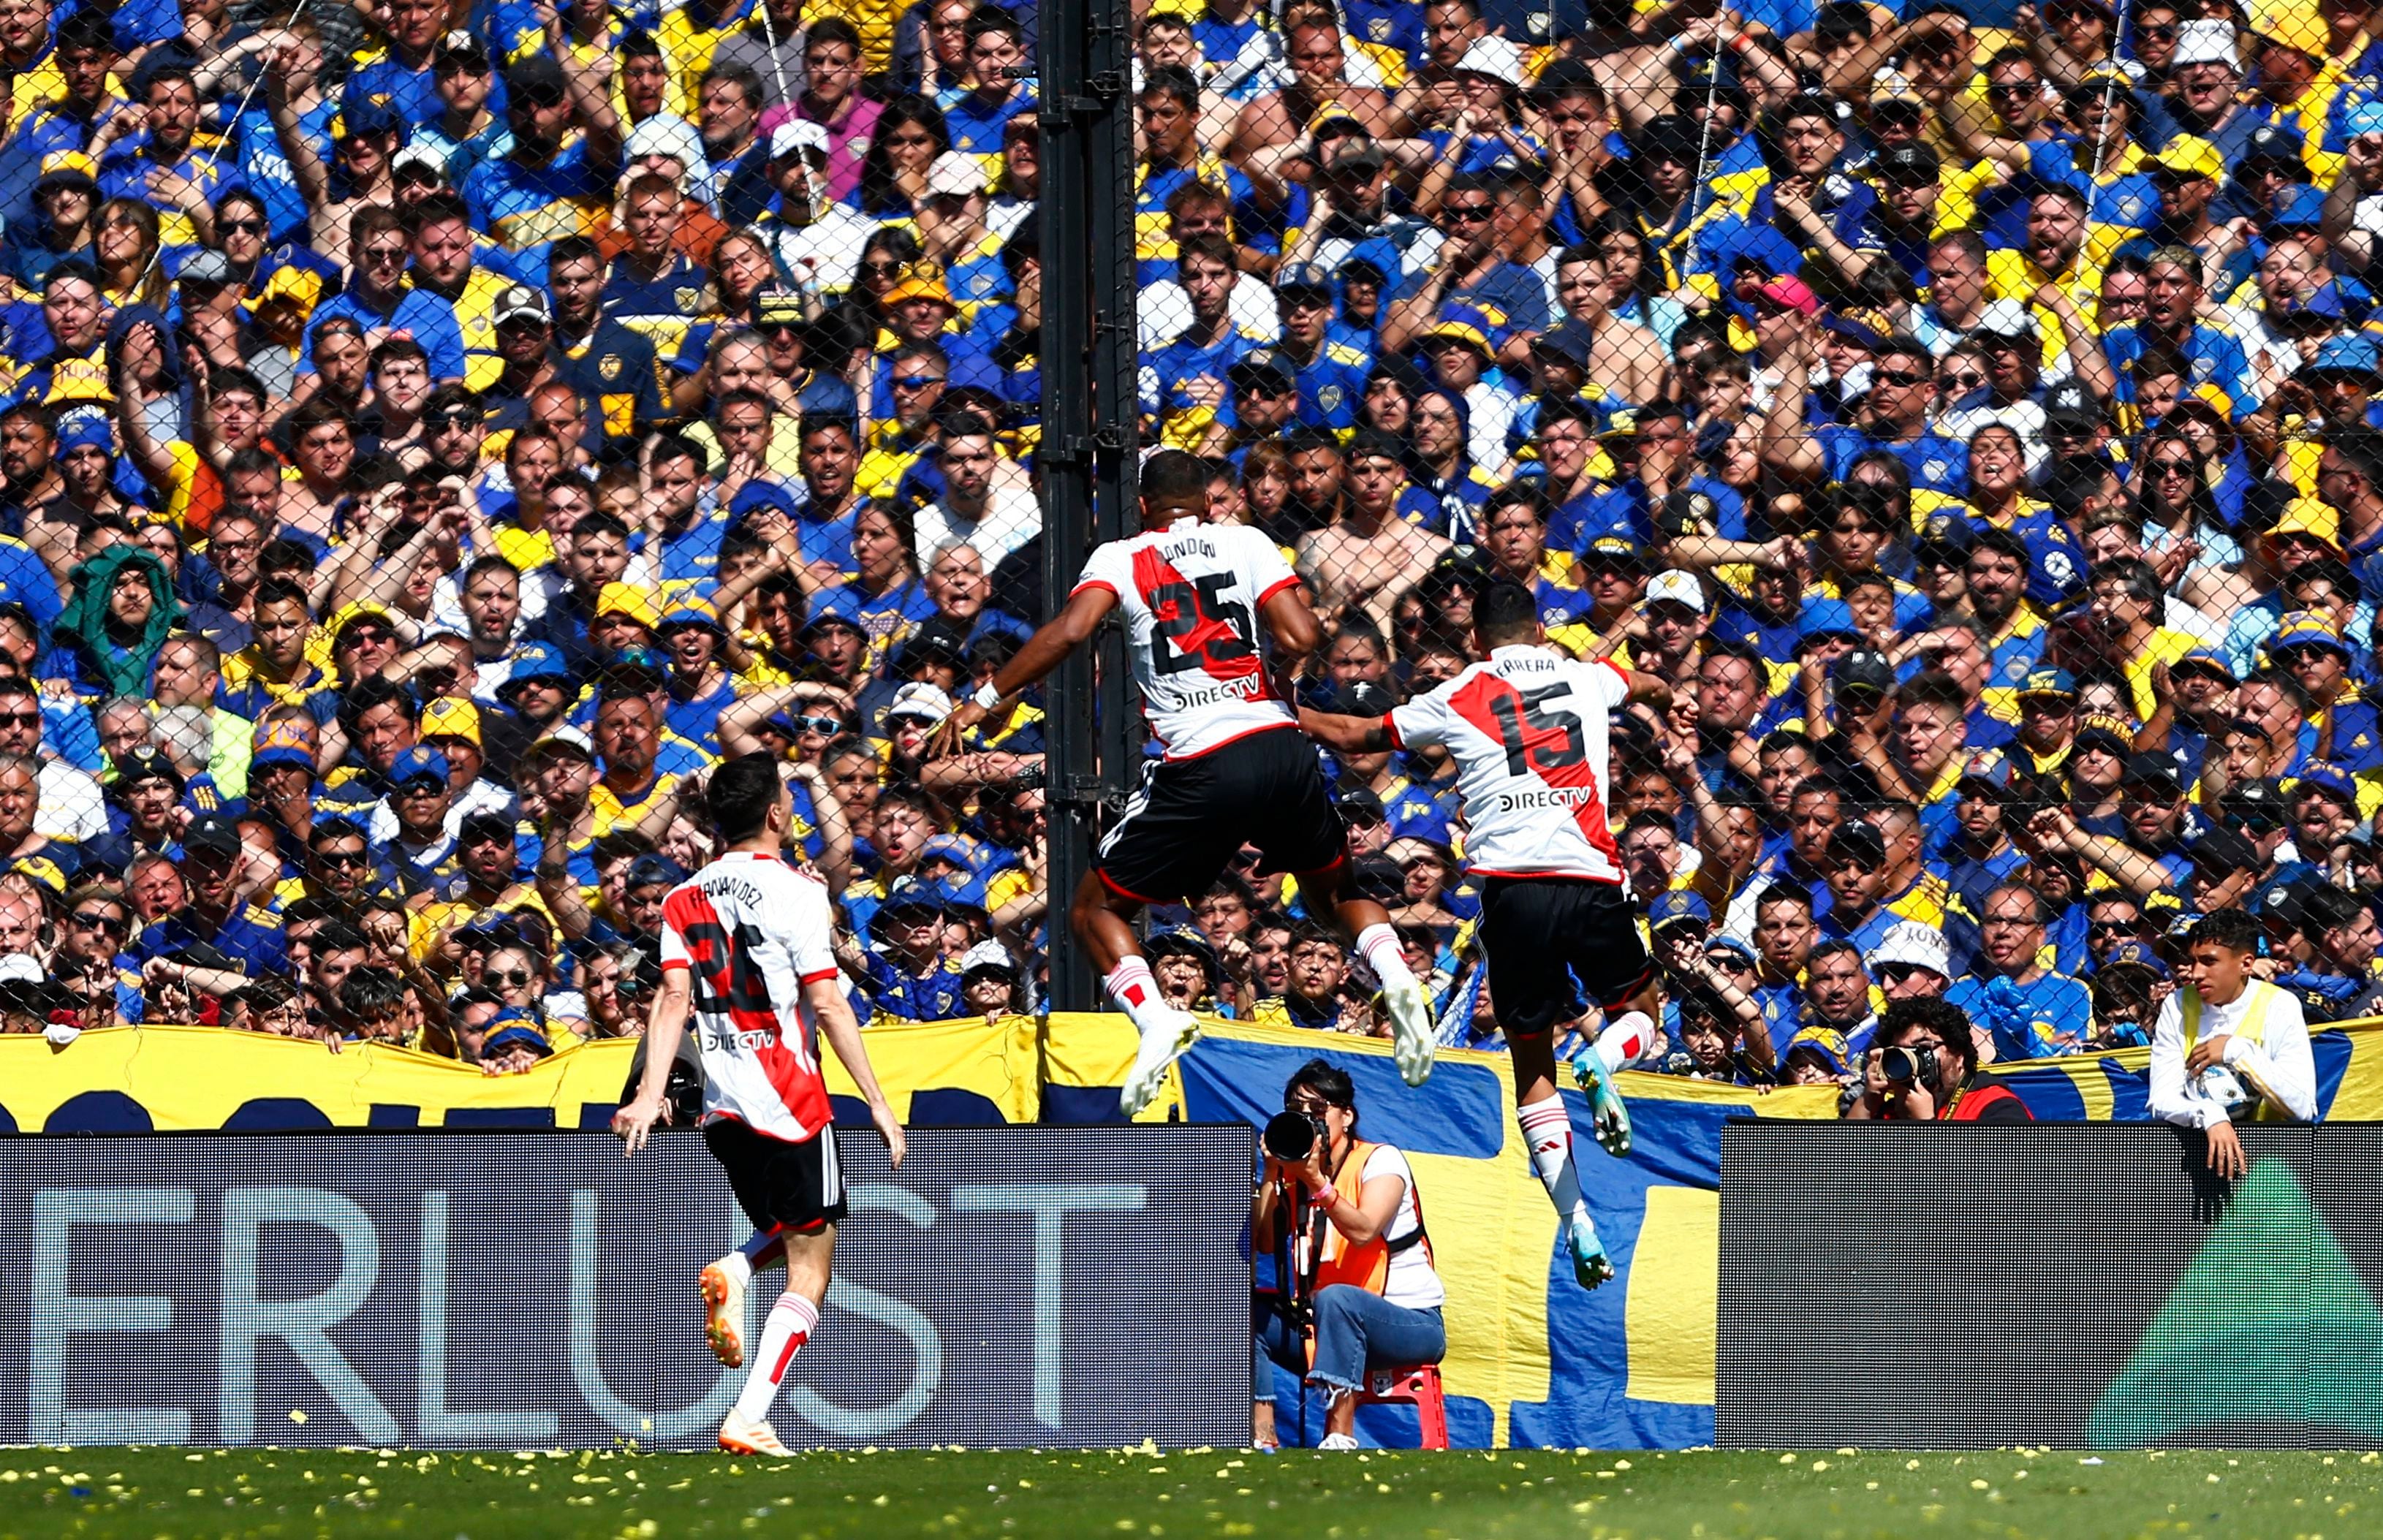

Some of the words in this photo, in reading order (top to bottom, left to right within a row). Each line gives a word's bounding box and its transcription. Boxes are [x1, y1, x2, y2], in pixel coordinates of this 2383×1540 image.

[1149, 570, 1257, 676] 25
[1171, 673, 1259, 713] DIRECTV
[1495, 659, 1555, 678] ERRERA
[1490, 681, 1585, 777] 15
[1499, 789, 1588, 813] DIRECTV
[689, 876, 762, 910] FERNANDEZ
[683, 920, 771, 1014] 26
[28, 1183, 1148, 1447] ERLUST
